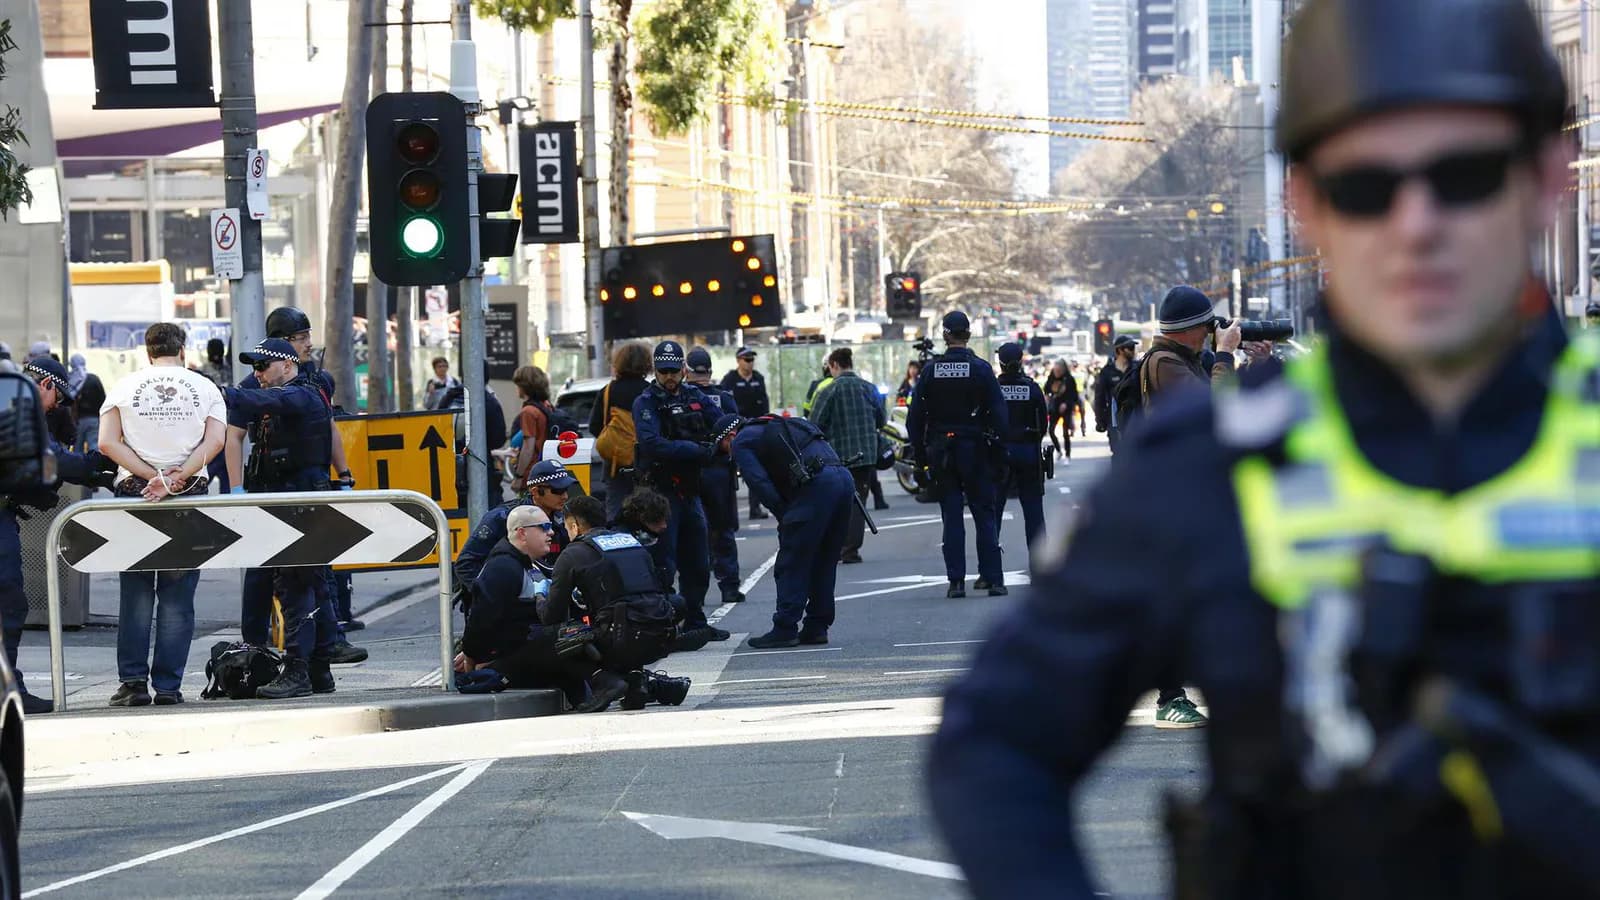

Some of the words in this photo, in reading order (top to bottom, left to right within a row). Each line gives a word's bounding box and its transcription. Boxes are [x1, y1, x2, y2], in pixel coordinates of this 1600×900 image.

[535, 132, 563, 233] acmi
[132, 376, 174, 408] BROOKLYN
[178, 378, 200, 408] BOUND
[598, 535, 637, 548] Police
